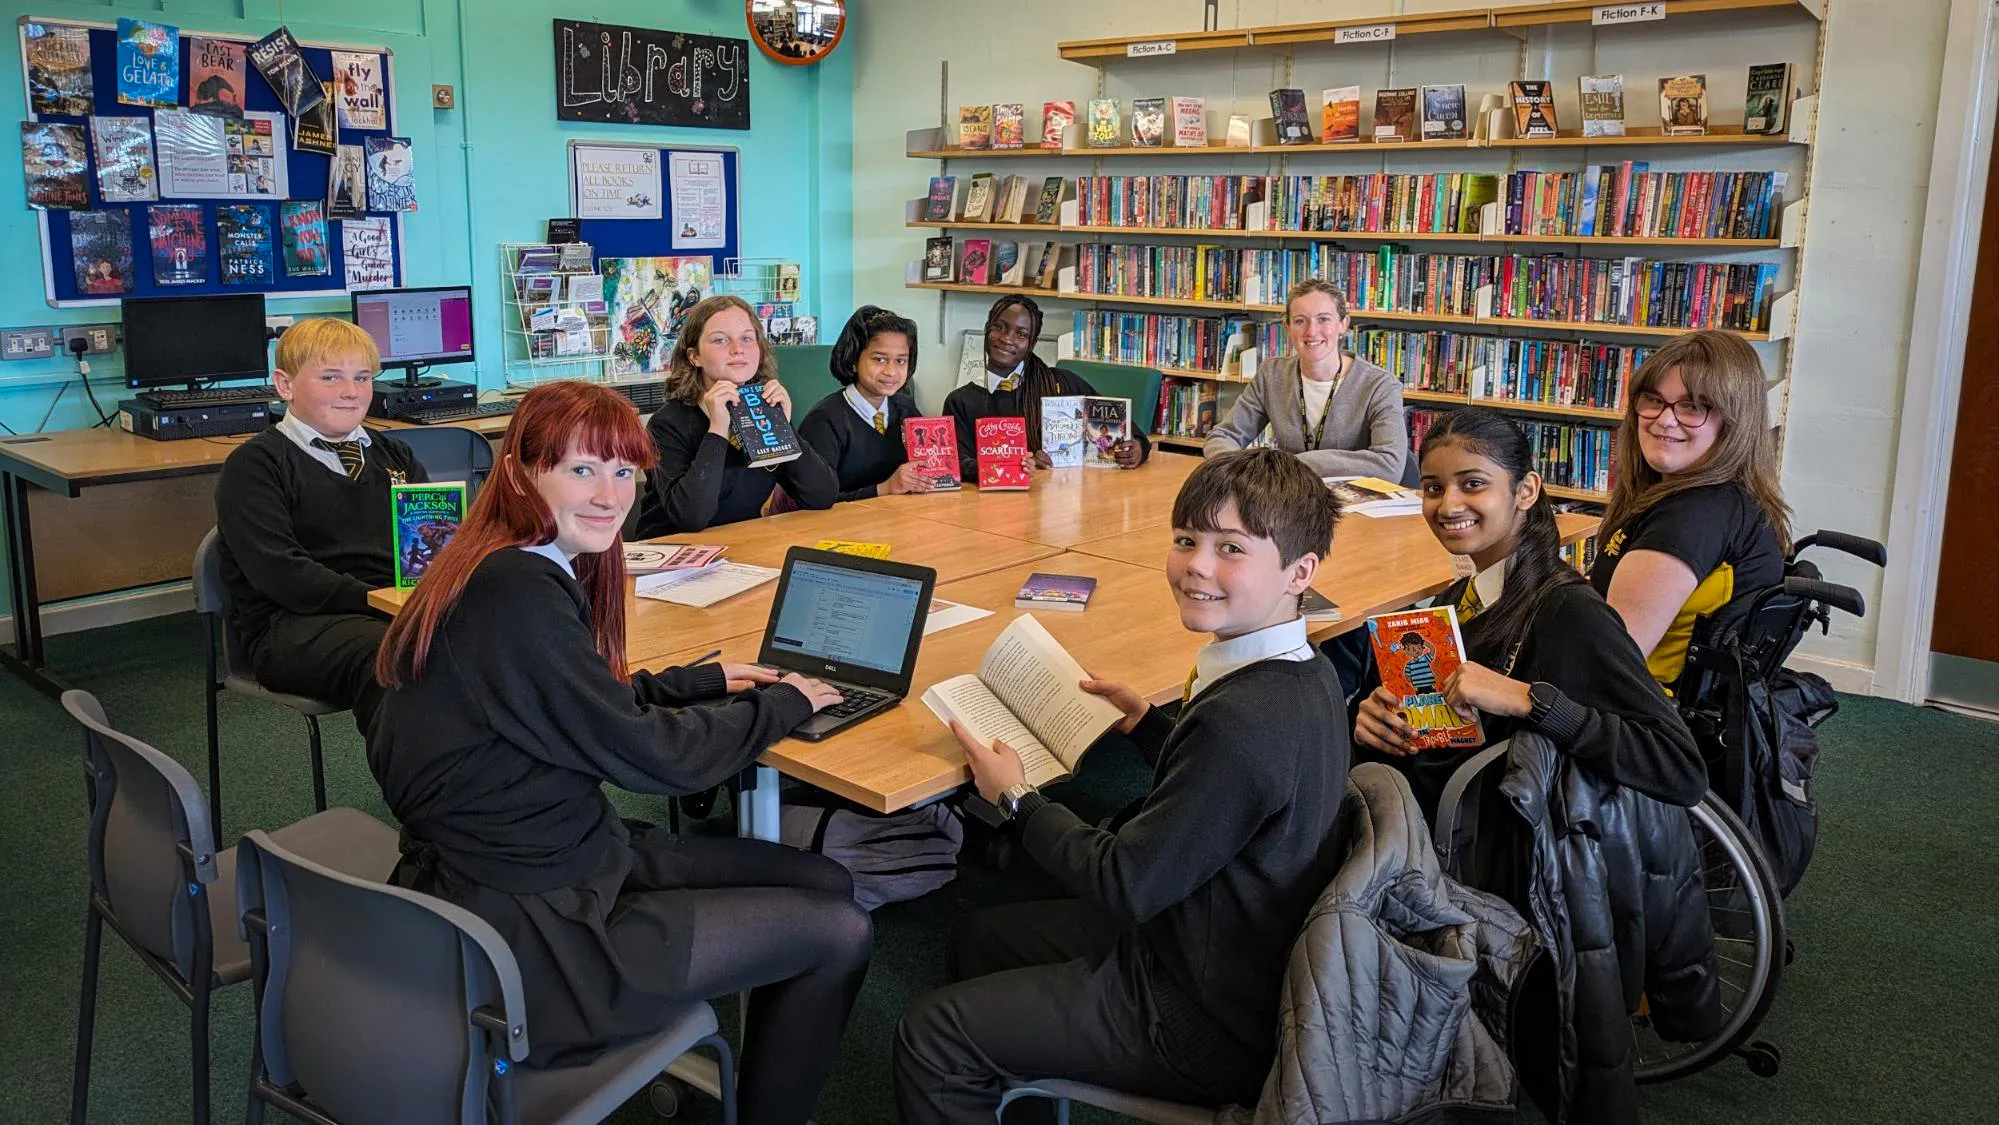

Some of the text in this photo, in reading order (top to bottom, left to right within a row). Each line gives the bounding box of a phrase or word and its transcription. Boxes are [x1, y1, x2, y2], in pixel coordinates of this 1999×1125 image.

[1609, 6, 1658, 20] Fiction F-K
[1343, 28, 1389, 39] Fiction C-F
[206, 43, 232, 56] LAST
[252, 34, 291, 64] RESIST
[1132, 44, 1172, 54] Fiction A-C
[133, 52, 167, 71] LOVE &
[201, 55, 234, 71] BEAR
[564, 27, 739, 106] Library
[122, 65, 174, 87] GELATO
[267, 65, 280, 77] TOM
[348, 62, 371, 81] fly
[1750, 80, 1783, 90] CLARE
[344, 94, 379, 108] wall
[1515, 96, 1550, 104] HISTORY
[1585, 94, 1611, 105] EMIL
[1096, 124, 1112, 132] WILD
[298, 130, 332, 140] JAMES
[1095, 131, 1113, 140] FOLK
[583, 163, 653, 175] PLEASE RETURN
[584, 176, 634, 186] ALL BOOKS
[64, 191, 87, 204] JONES
[584, 189, 622, 199] ON TIME
[152, 208, 204, 236] SOMEONE
[175, 220, 186, 232] IS
[358, 230, 382, 242] Good
[234, 239, 257, 247] CALLS
[351, 243, 378, 259] Girl's
[228, 264, 265, 274] NESS
[360, 260, 386, 270] Guide
[351, 270, 389, 283] Murder
[1092, 406, 1118, 418] MIA
[744, 393, 780, 446] BLUE
[980, 422, 998, 437] Cathy
[914, 447, 952, 457] SCARLET
[980, 444, 1025, 458] SCARLETT
[412, 493, 447, 501] PERCY
[404, 501, 456, 515] JACKSON
[1387, 617, 1430, 628] ZANIB MIAN
[825, 664, 837, 672] DELL
[1405, 694, 1446, 707] PLANE
[1423, 730, 1452, 747] TROUBLE
